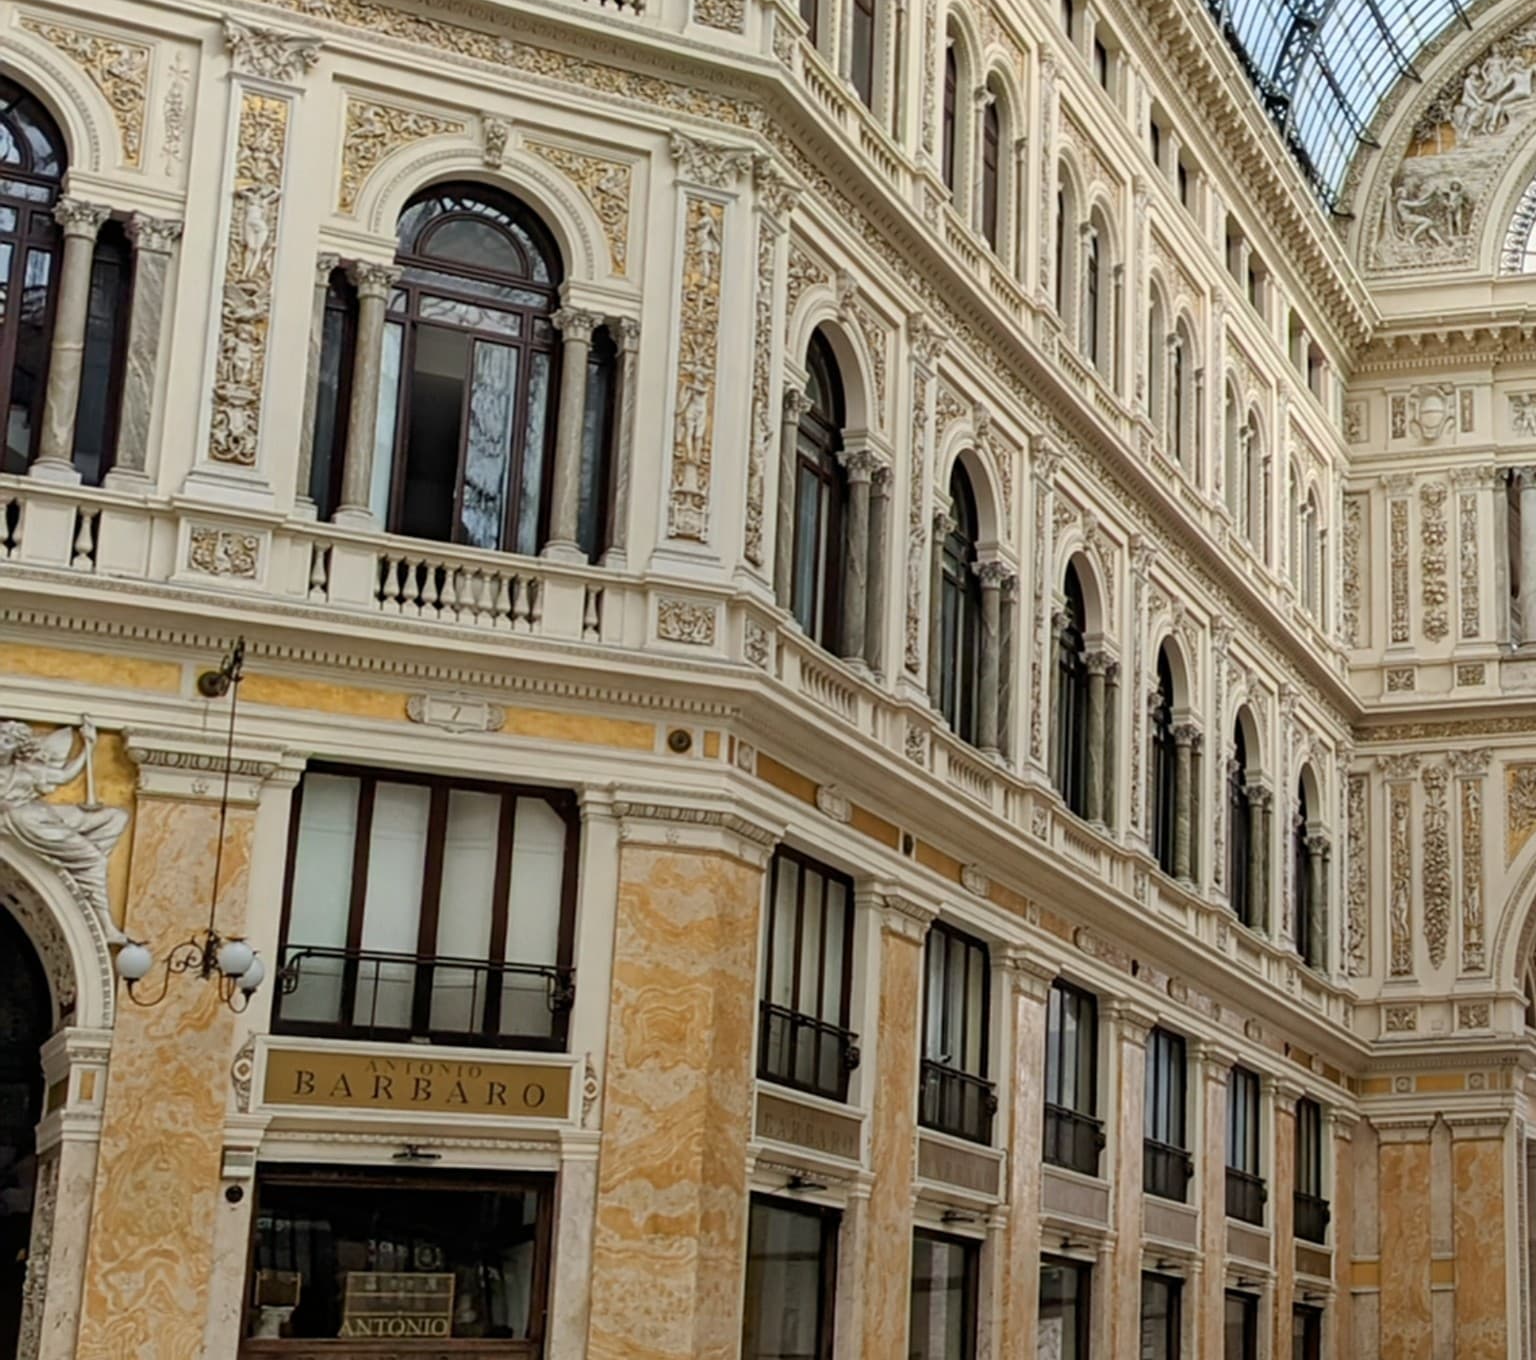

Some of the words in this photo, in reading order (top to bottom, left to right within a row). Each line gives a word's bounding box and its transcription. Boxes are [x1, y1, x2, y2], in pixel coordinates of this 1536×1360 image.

[365, 1059, 483, 1079] ANTONIO
[293, 1069, 546, 1109] BARBARO
[338, 1317, 449, 1337] ANTONIO
